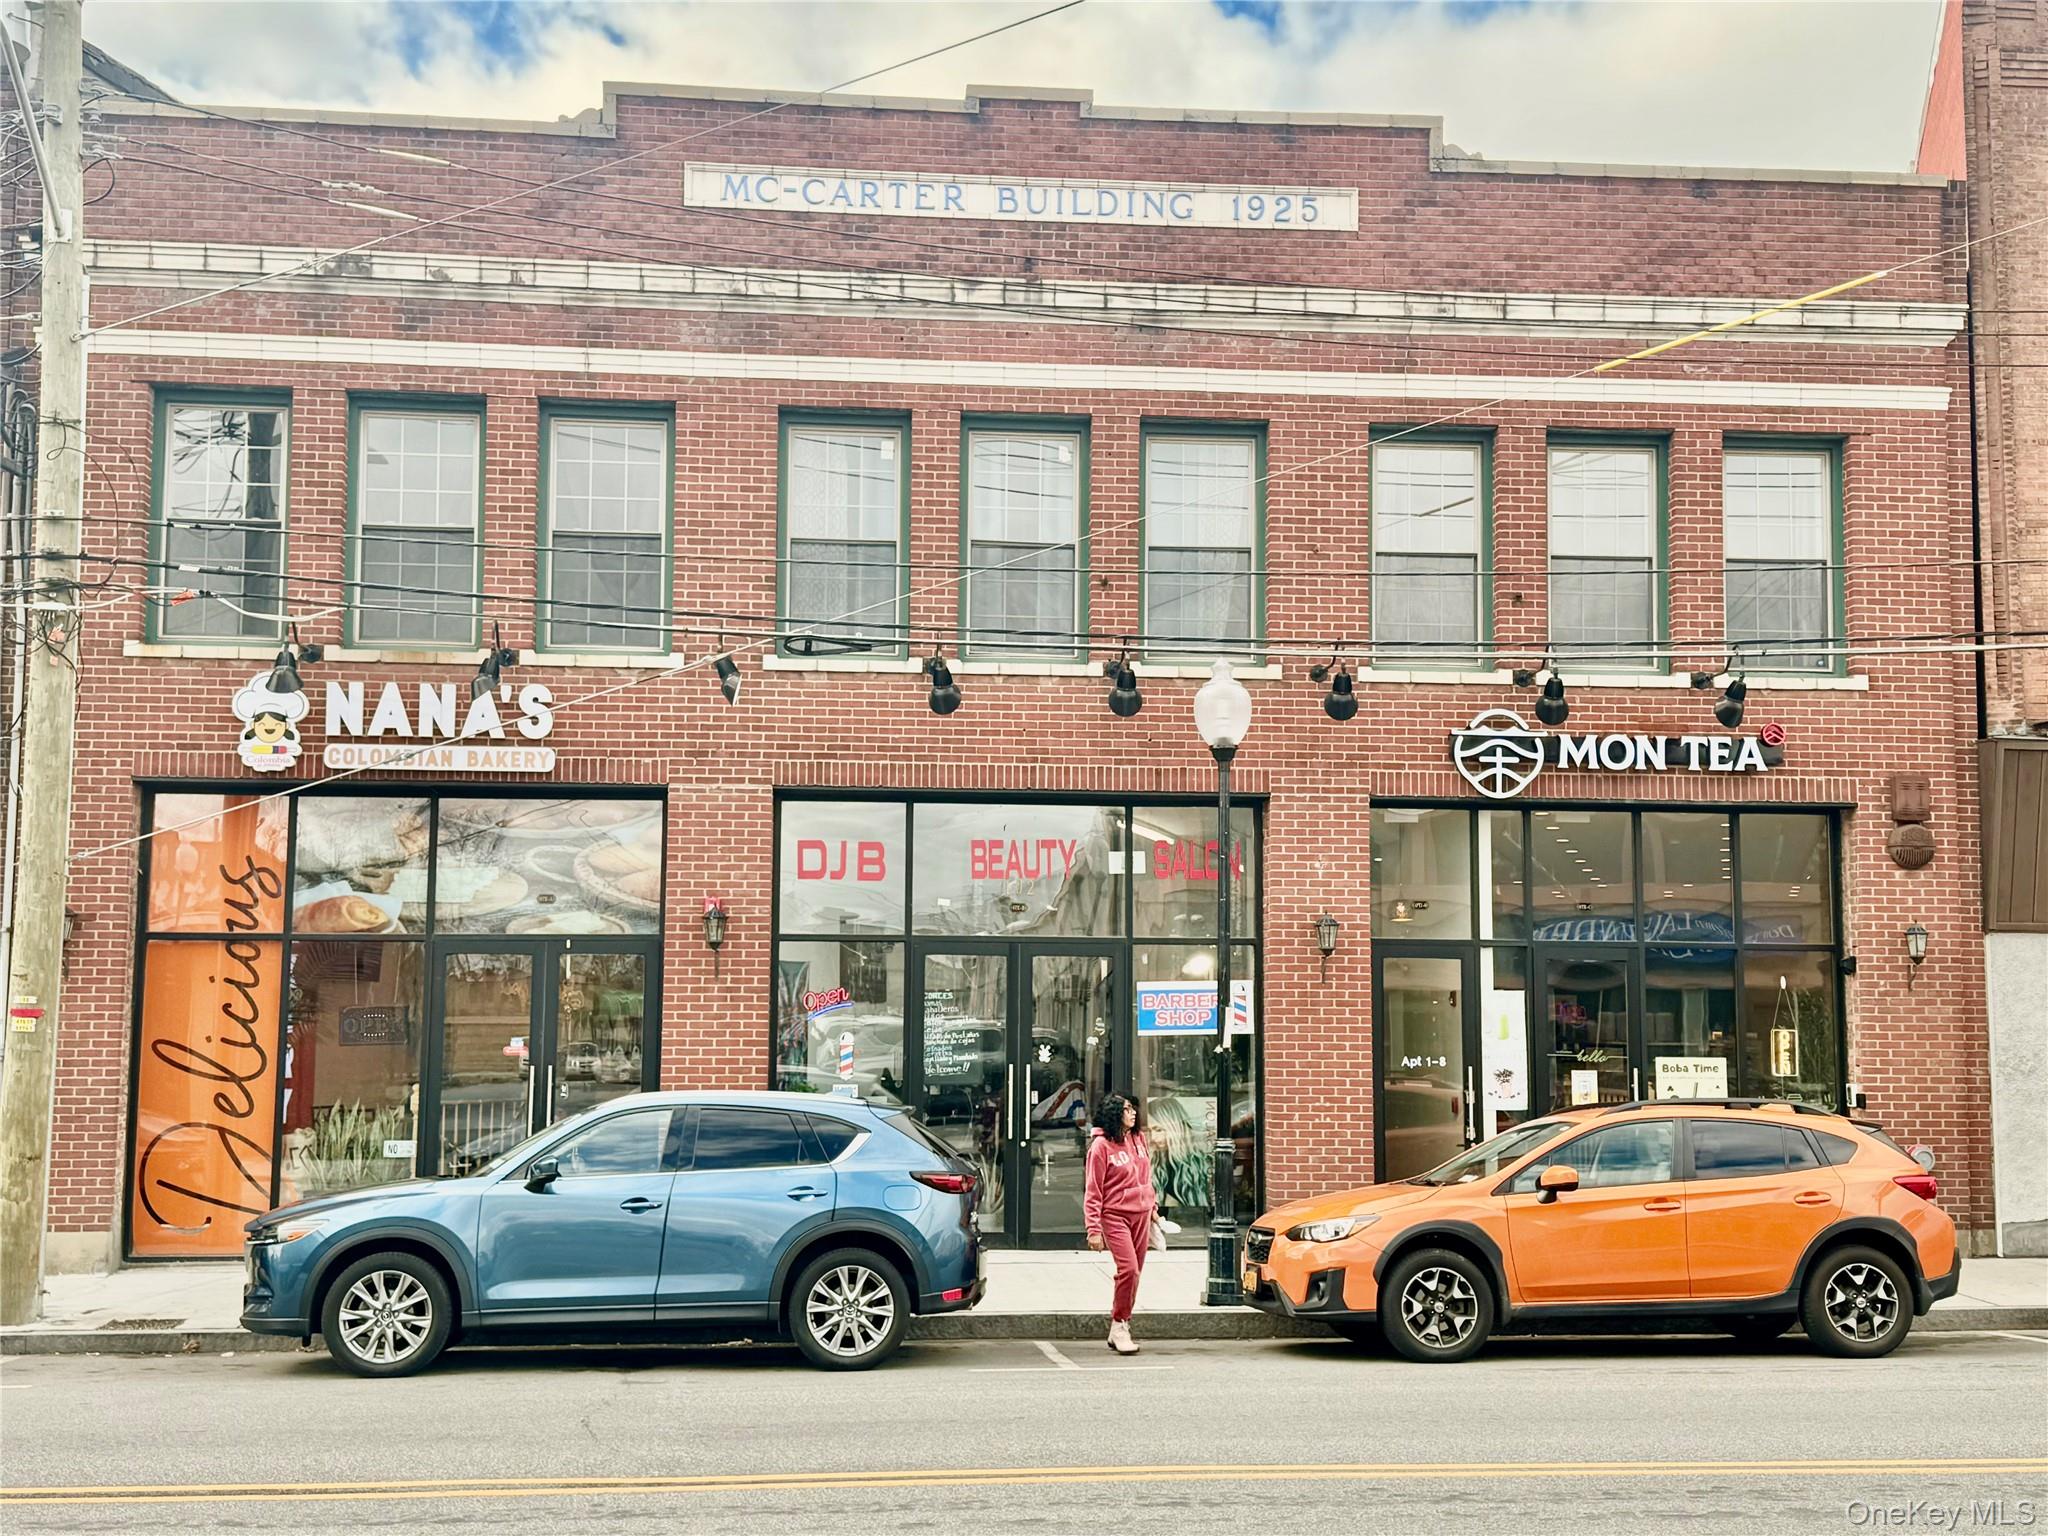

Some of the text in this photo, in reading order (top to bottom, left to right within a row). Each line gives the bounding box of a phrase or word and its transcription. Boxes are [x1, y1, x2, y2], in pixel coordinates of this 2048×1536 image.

[721, 173, 1320, 224] MC-CARTER BUILDING 1925
[325, 681, 554, 739] NANA'S
[328, 747, 551, 770] COLOMBIAN BAKERY
[1556, 733, 1769, 772] MON TEA
[970, 838, 1078, 881] BEAUTY
[803, 987, 849, 1012] Open
[1155, 1009, 1212, 1027] SHOP
[138, 855, 282, 1234] Delicious
[1576, 1048, 1609, 1063] hello
[1778, 1031, 1792, 1075] OPEN
[1401, 1055, 1447, 1069] Apt 1-8
[1662, 1063, 1720, 1073] Boba Time
[387, 1143, 399, 1155] NO
